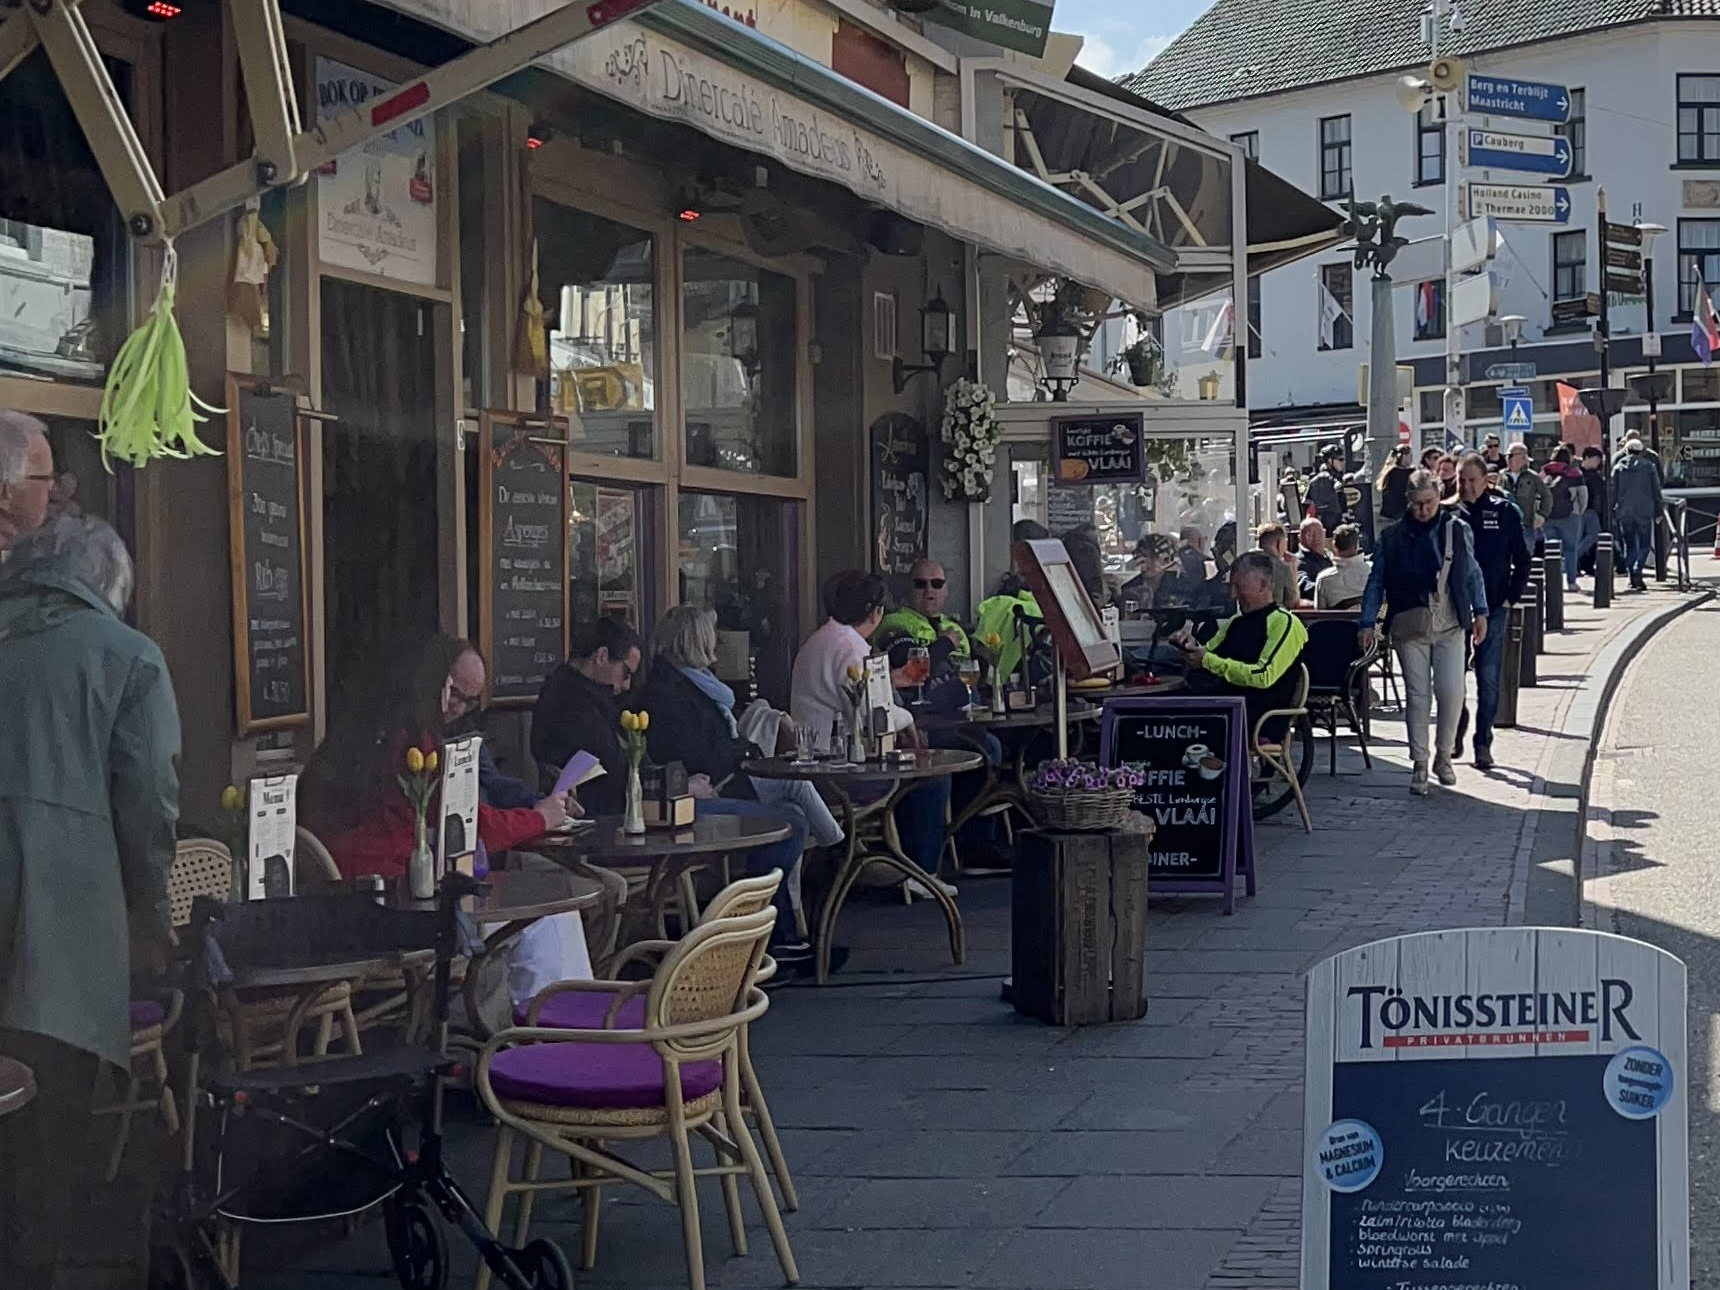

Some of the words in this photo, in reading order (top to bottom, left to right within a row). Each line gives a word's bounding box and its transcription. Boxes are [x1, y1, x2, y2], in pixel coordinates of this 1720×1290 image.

[1471, 79, 1493, 93] Berg
[1497, 84, 1508, 93] en
[1512, 84, 1548, 100] Terblijt
[1471, 95, 1524, 111] Maastricht
[769, 97, 852, 167] Amadeus
[1484, 135, 1524, 151] Cauberg
[1473, 189, 1508, 199] Holland
[1511, 190, 1542, 200] Casino
[1485, 203, 1526, 215] Thermae
[1066, 434, 1112, 447] KOFFIE
[1088, 456, 1132, 470] VLAAI
[1150, 770, 1186, 786] FFIE
[1156, 808, 1216, 825] VLAAI
[1347, 979, 1642, 1049] TÖNISSTEINER
[1407, 1032, 1567, 1046] PRIVATBRUNNEN
[1624, 1057, 1664, 1077] ZONDER
[1619, 1089, 1655, 1108] SUIKER
[1319, 1138, 1375, 1165] MAGNESIUM
[1335, 1155, 1376, 1176] CALCIUM
